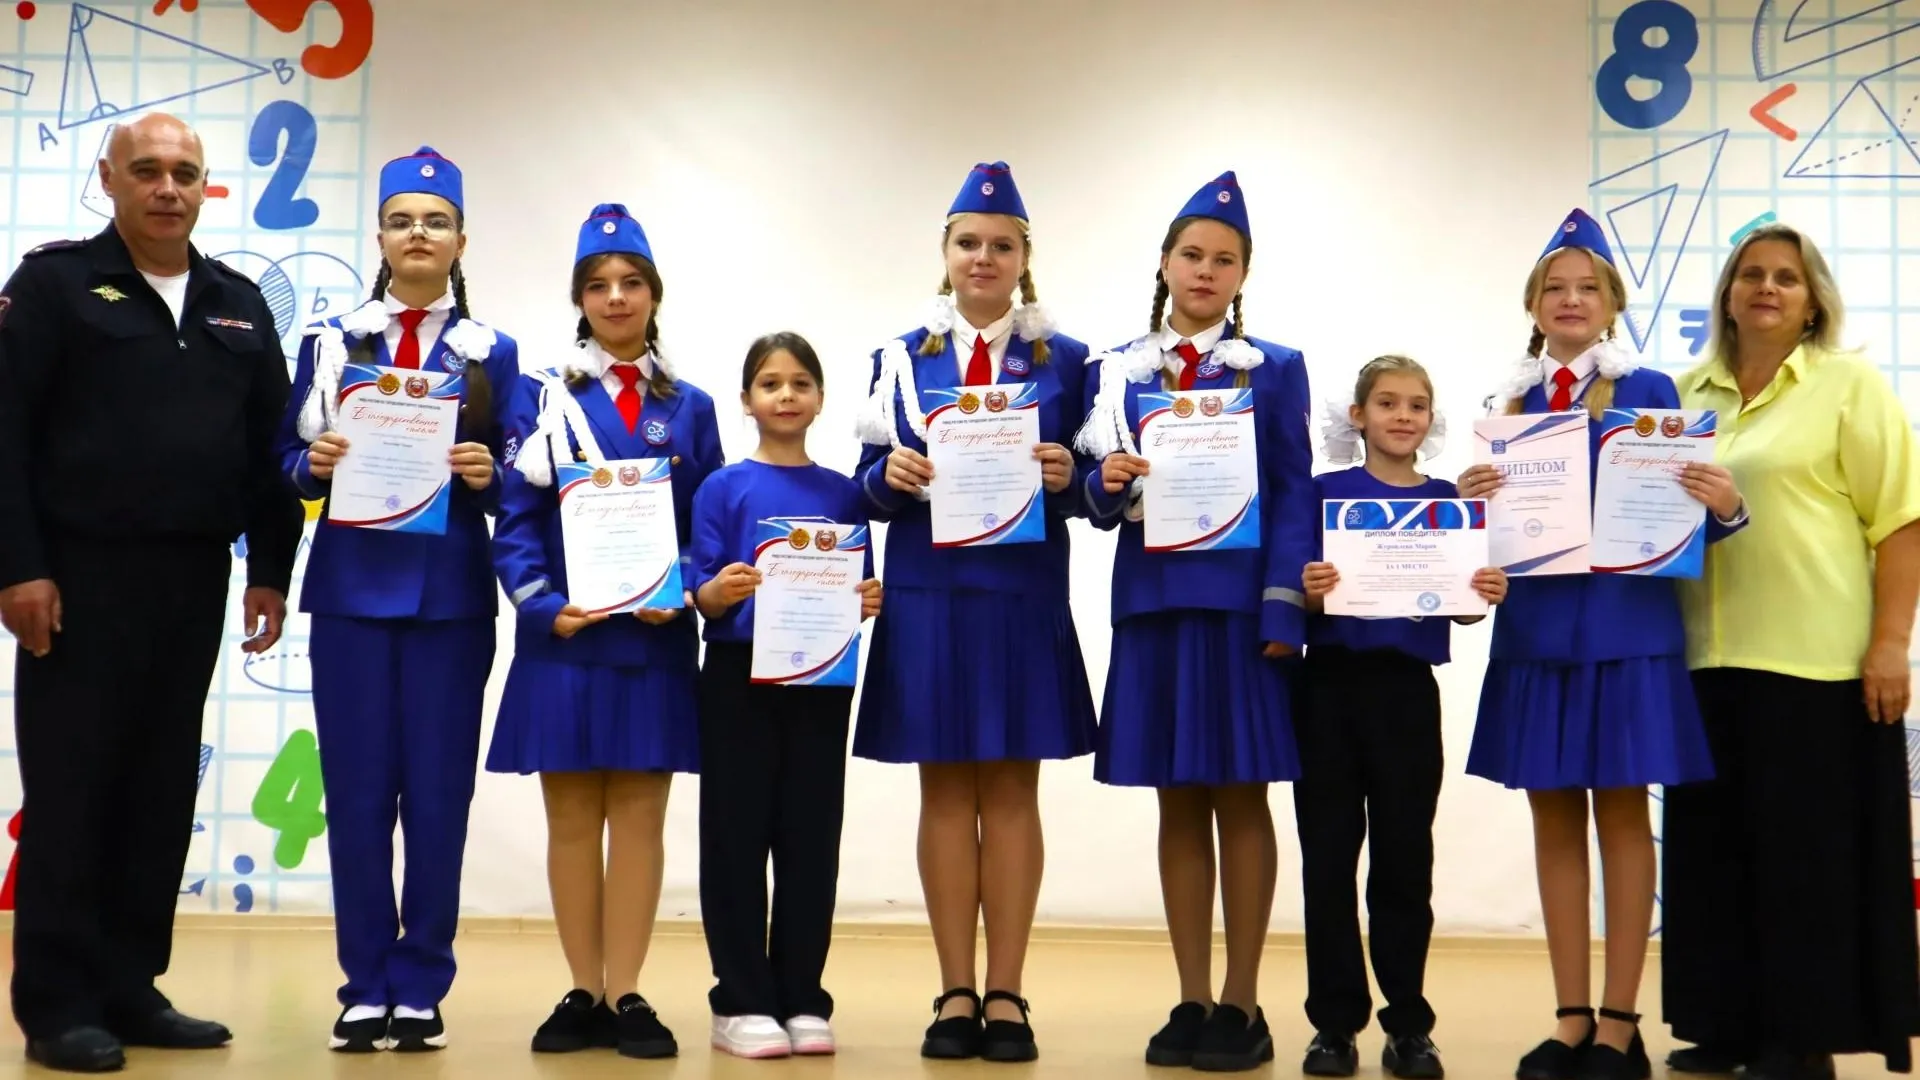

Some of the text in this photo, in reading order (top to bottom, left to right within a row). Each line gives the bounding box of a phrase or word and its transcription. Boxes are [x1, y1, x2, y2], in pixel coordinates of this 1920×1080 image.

[1595, 0, 1699, 130] 8
[248, 99, 320, 231] 2
[1364, 530, 1396, 538] ДИПЛОМ
[251, 729, 327, 870] 4
